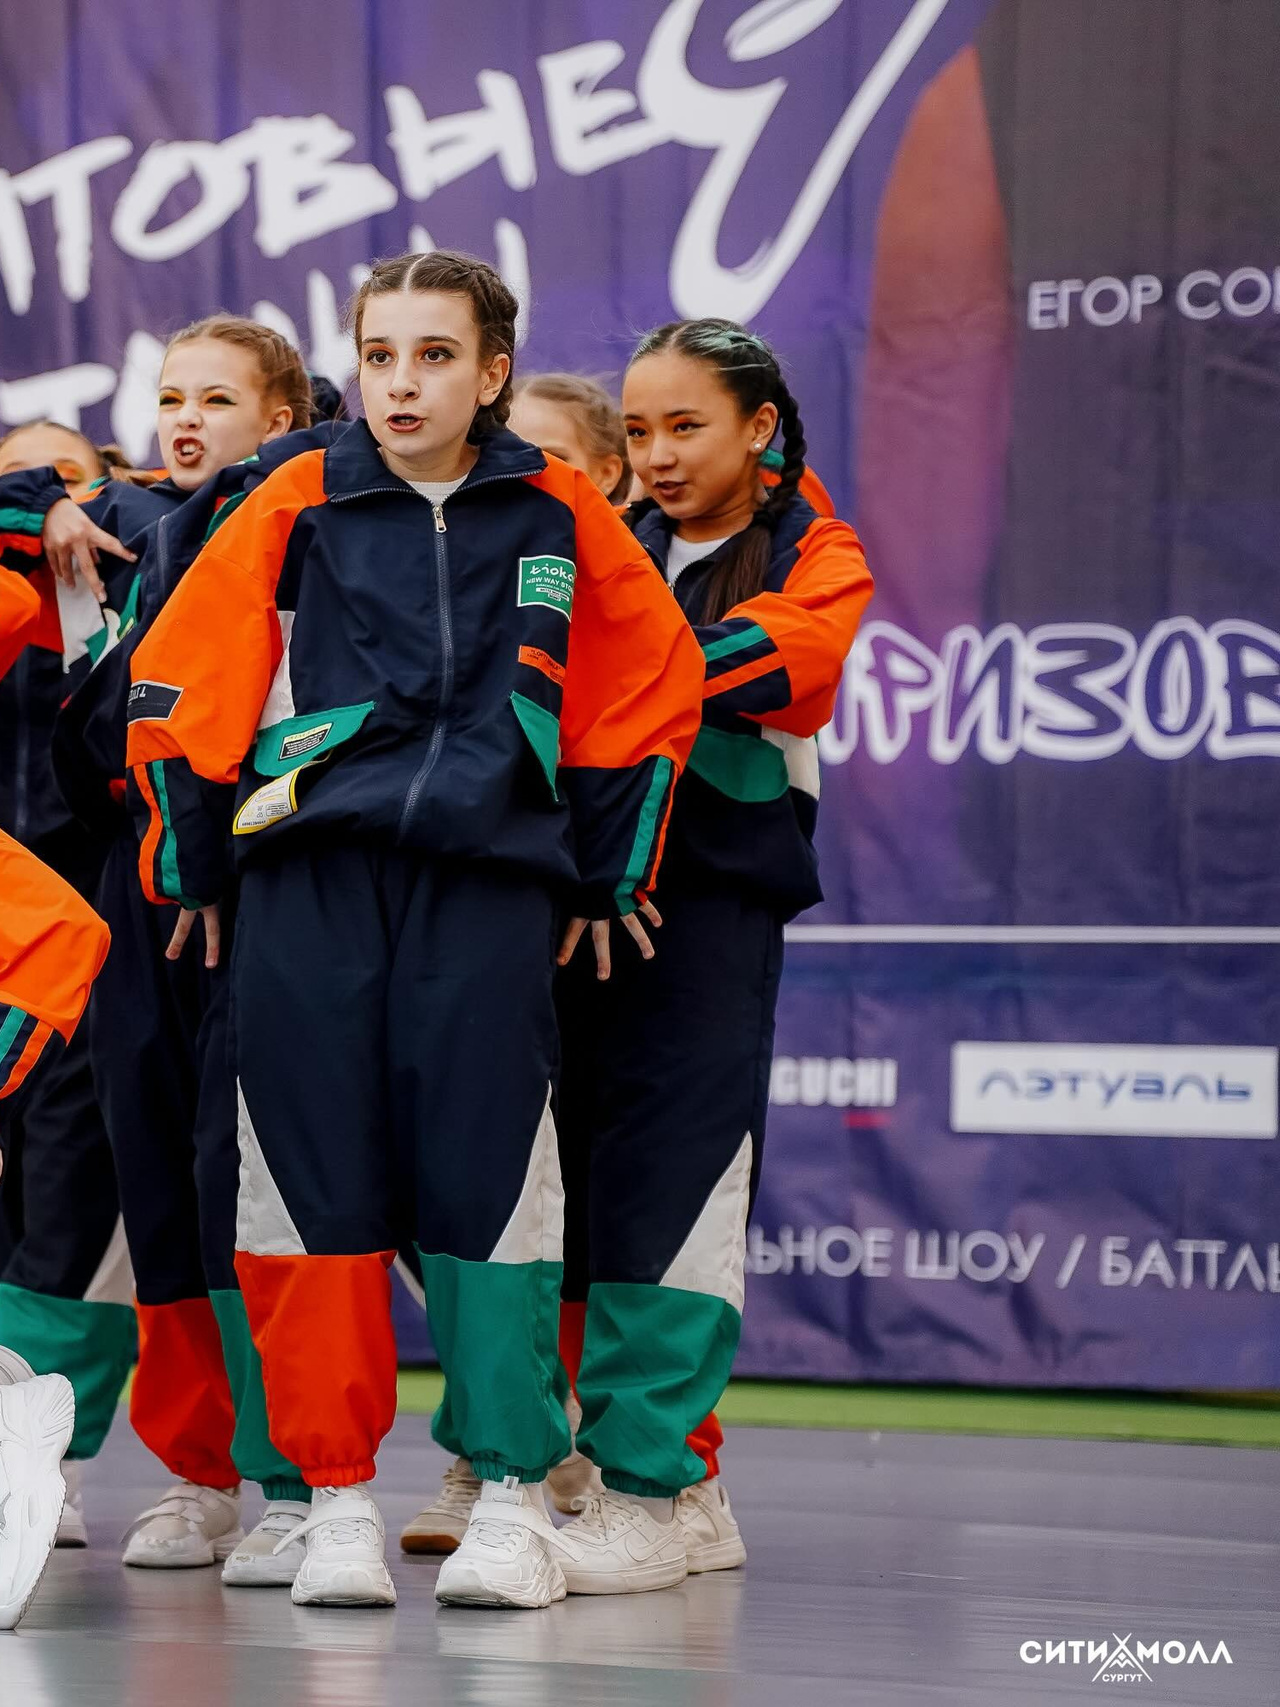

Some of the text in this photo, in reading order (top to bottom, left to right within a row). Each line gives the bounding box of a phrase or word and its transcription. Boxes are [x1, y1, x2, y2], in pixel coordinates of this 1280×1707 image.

[1027, 265, 1280, 331] ЕГОР СО
[544, 577, 560, 586] WAY
[744, 1224, 894, 1279] ЬНОЕ
[904, 1229, 1045, 1283] ШОУ
